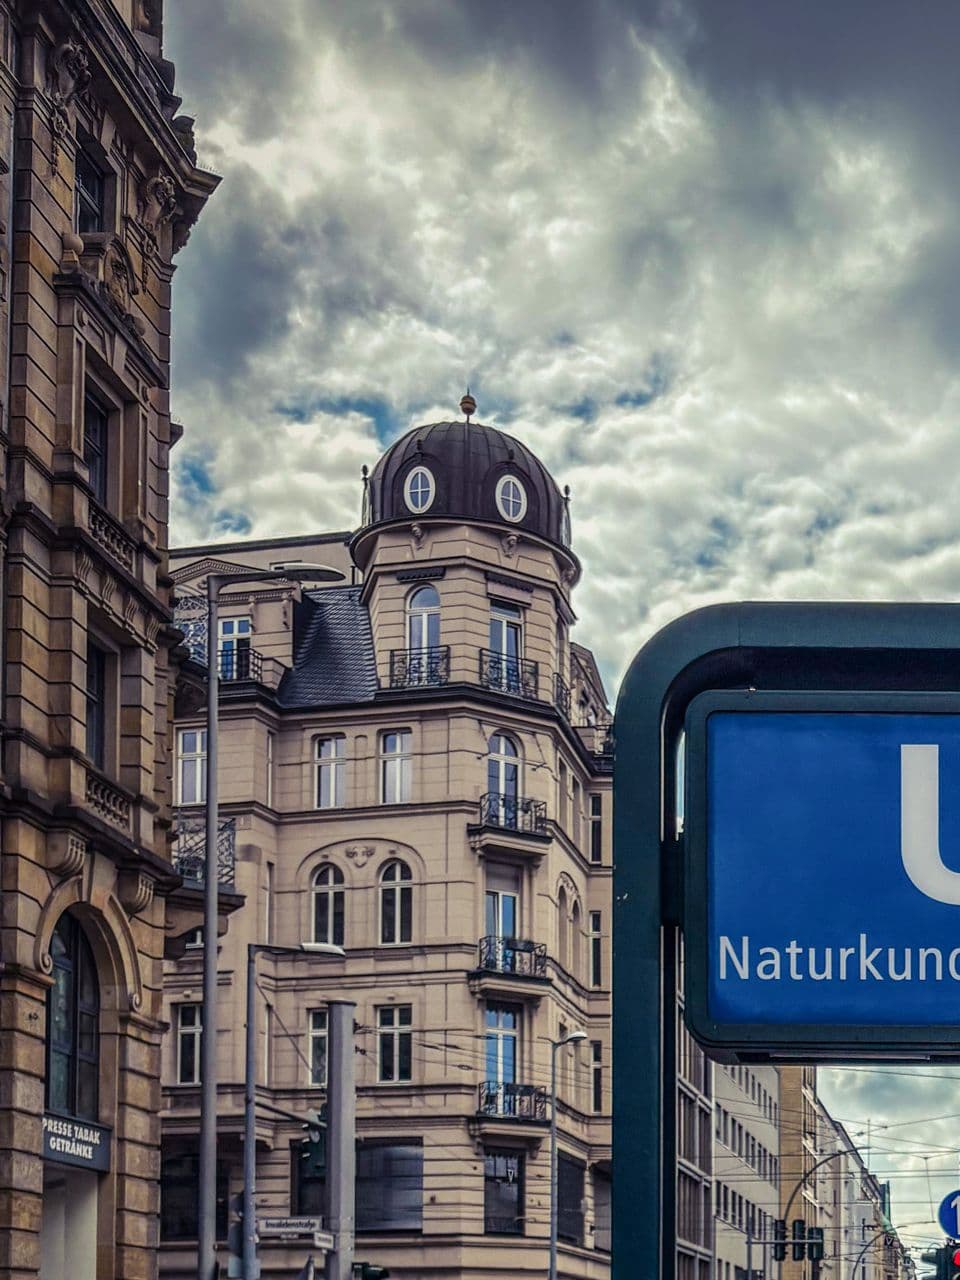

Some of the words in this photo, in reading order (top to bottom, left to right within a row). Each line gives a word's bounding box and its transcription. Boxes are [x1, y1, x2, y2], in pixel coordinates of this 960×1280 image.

[42, 1117, 73, 1137] PRESSE
[73, 1125, 100, 1145] TABAK
[49, 1136, 93, 1160] GETRÄNKE
